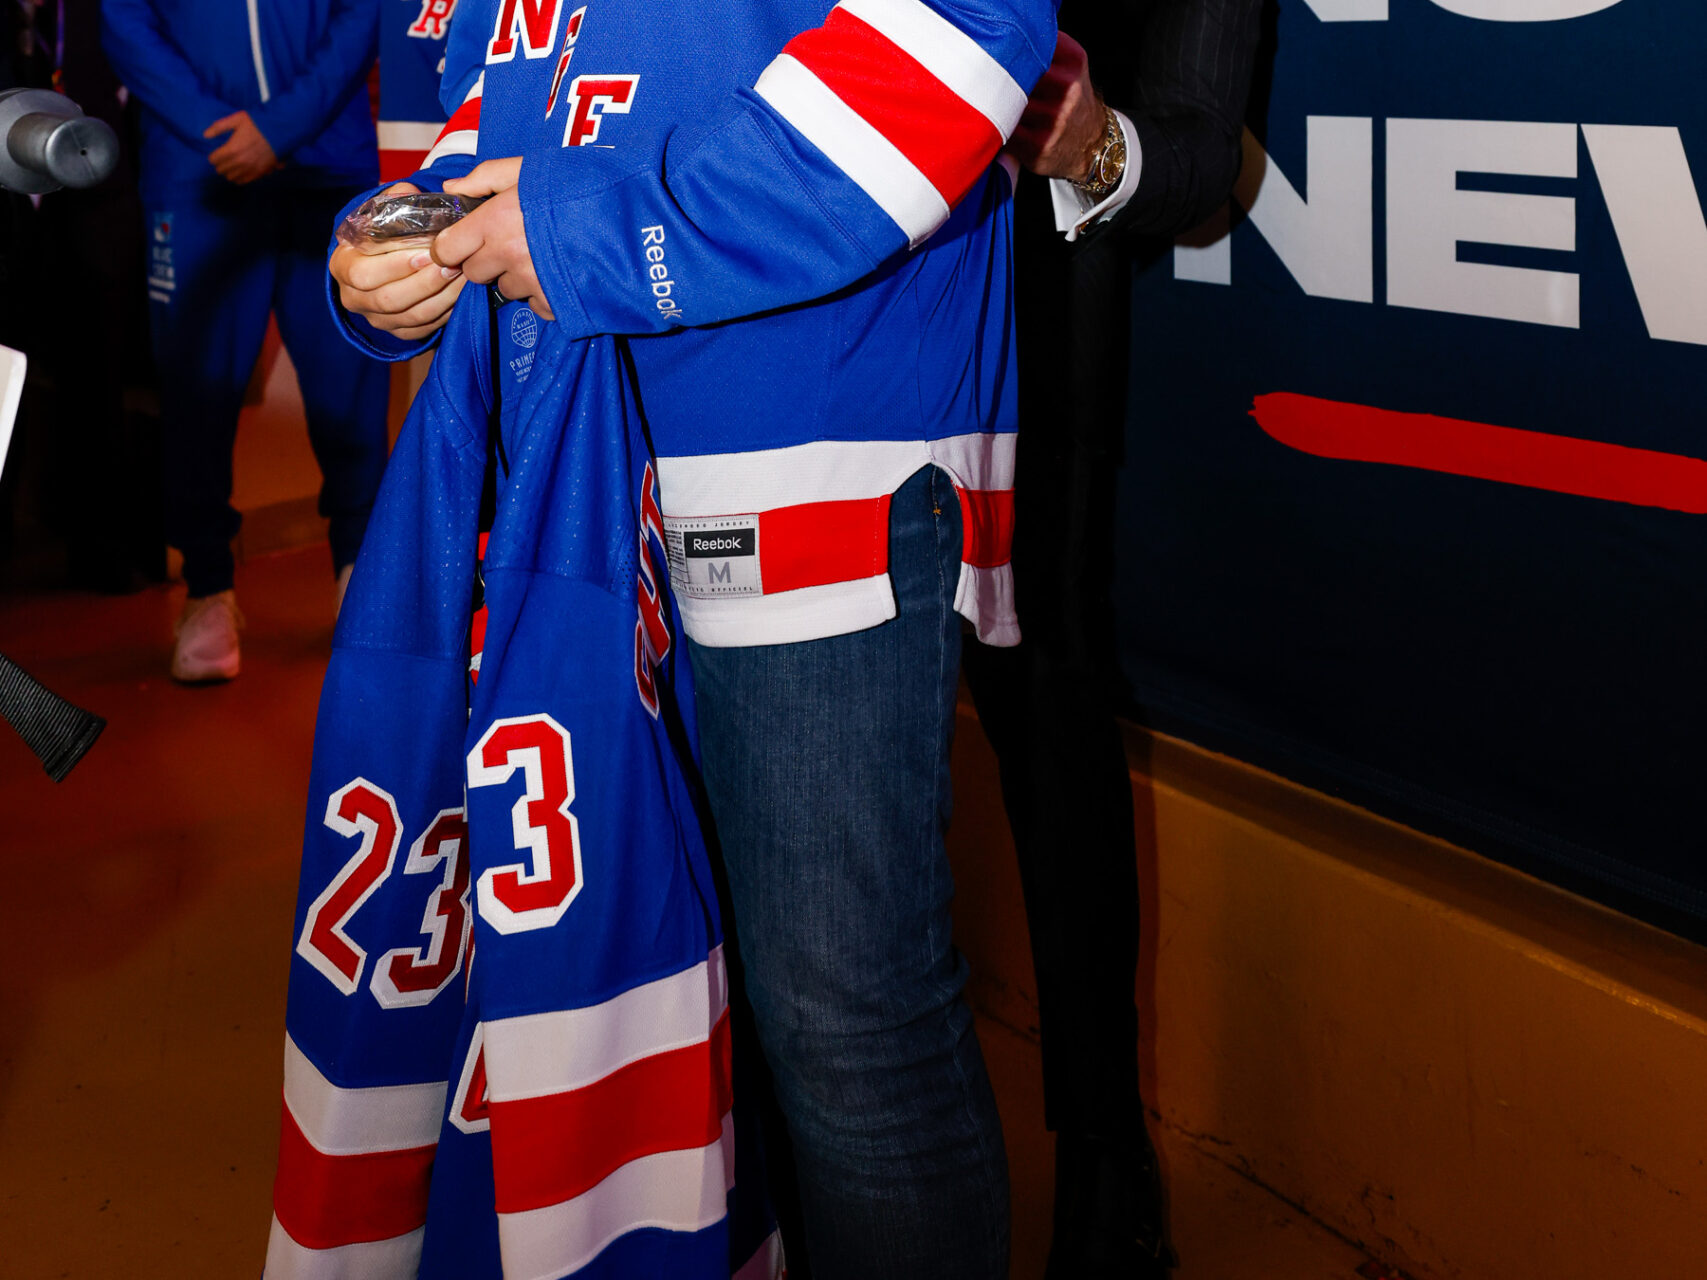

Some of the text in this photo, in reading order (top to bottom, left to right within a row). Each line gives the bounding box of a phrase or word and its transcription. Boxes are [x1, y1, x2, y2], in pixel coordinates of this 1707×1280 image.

[641, 225, 683, 320] Reebok
[693, 536, 742, 551] Reebok
[707, 561, 732, 585] M
[296, 776, 472, 1010] 23
